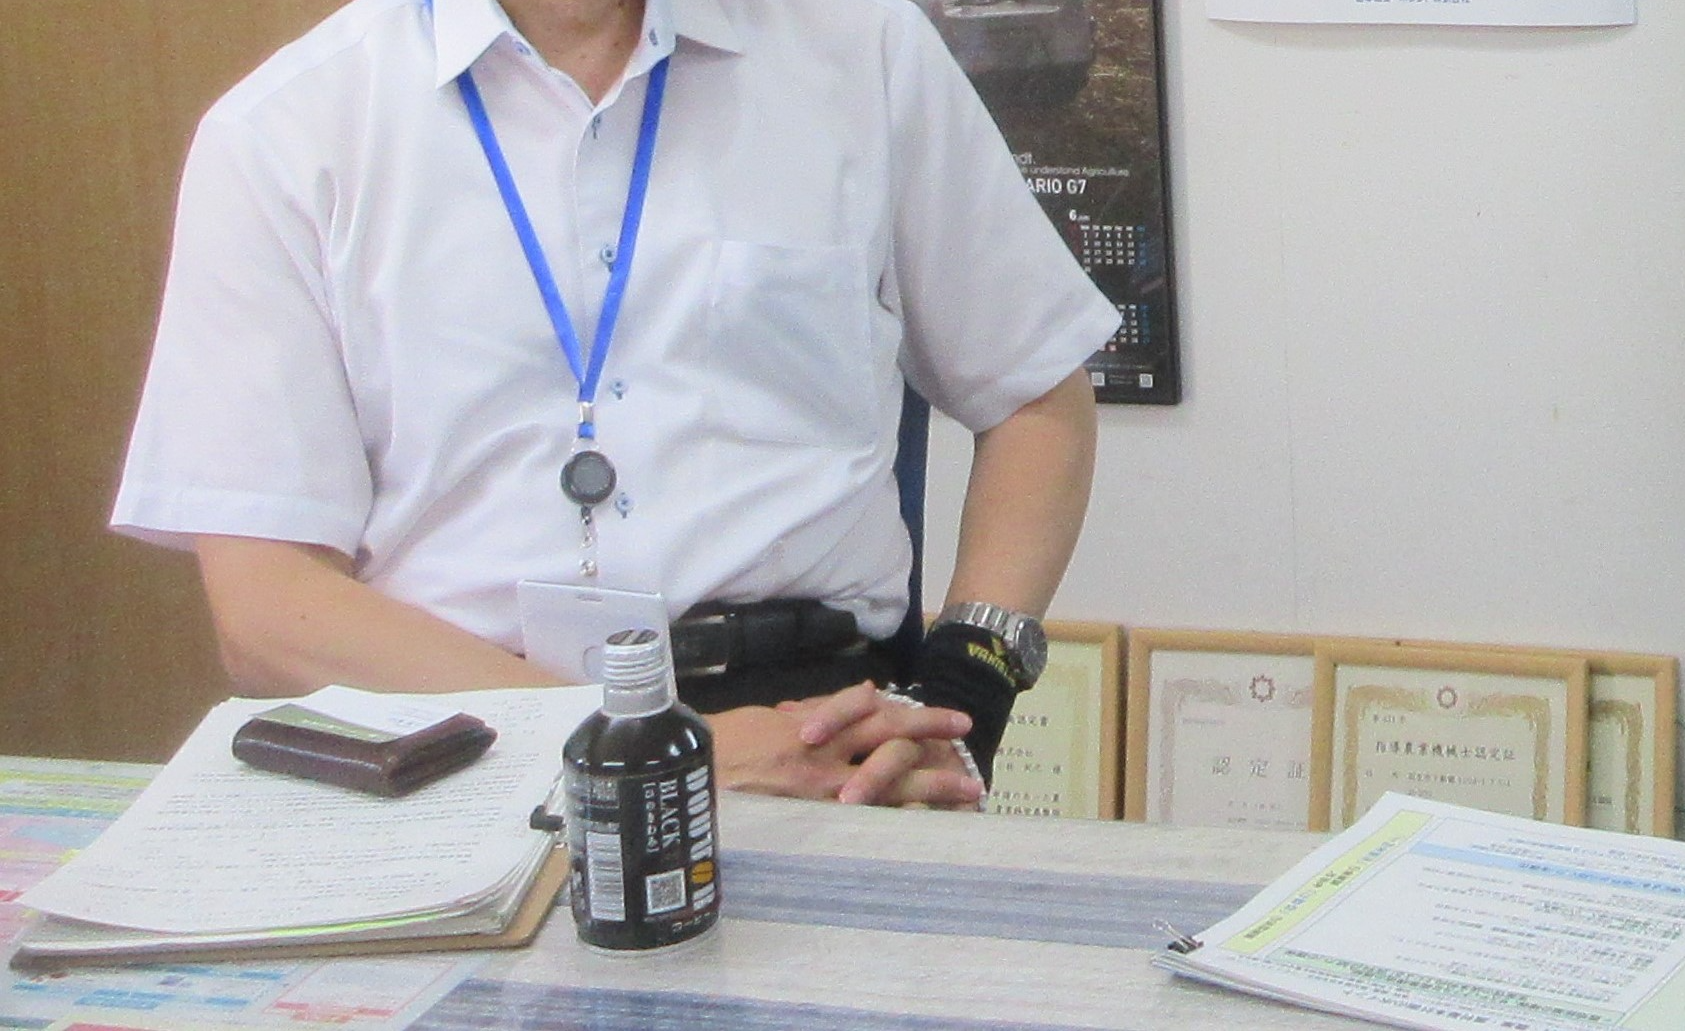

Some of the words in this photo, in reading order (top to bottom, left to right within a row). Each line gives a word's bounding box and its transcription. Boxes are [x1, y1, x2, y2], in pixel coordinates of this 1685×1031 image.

[1025, 177, 1063, 194] ARIO
[1066, 178, 1087, 195] G7
[659, 778, 681, 850] BLACK
